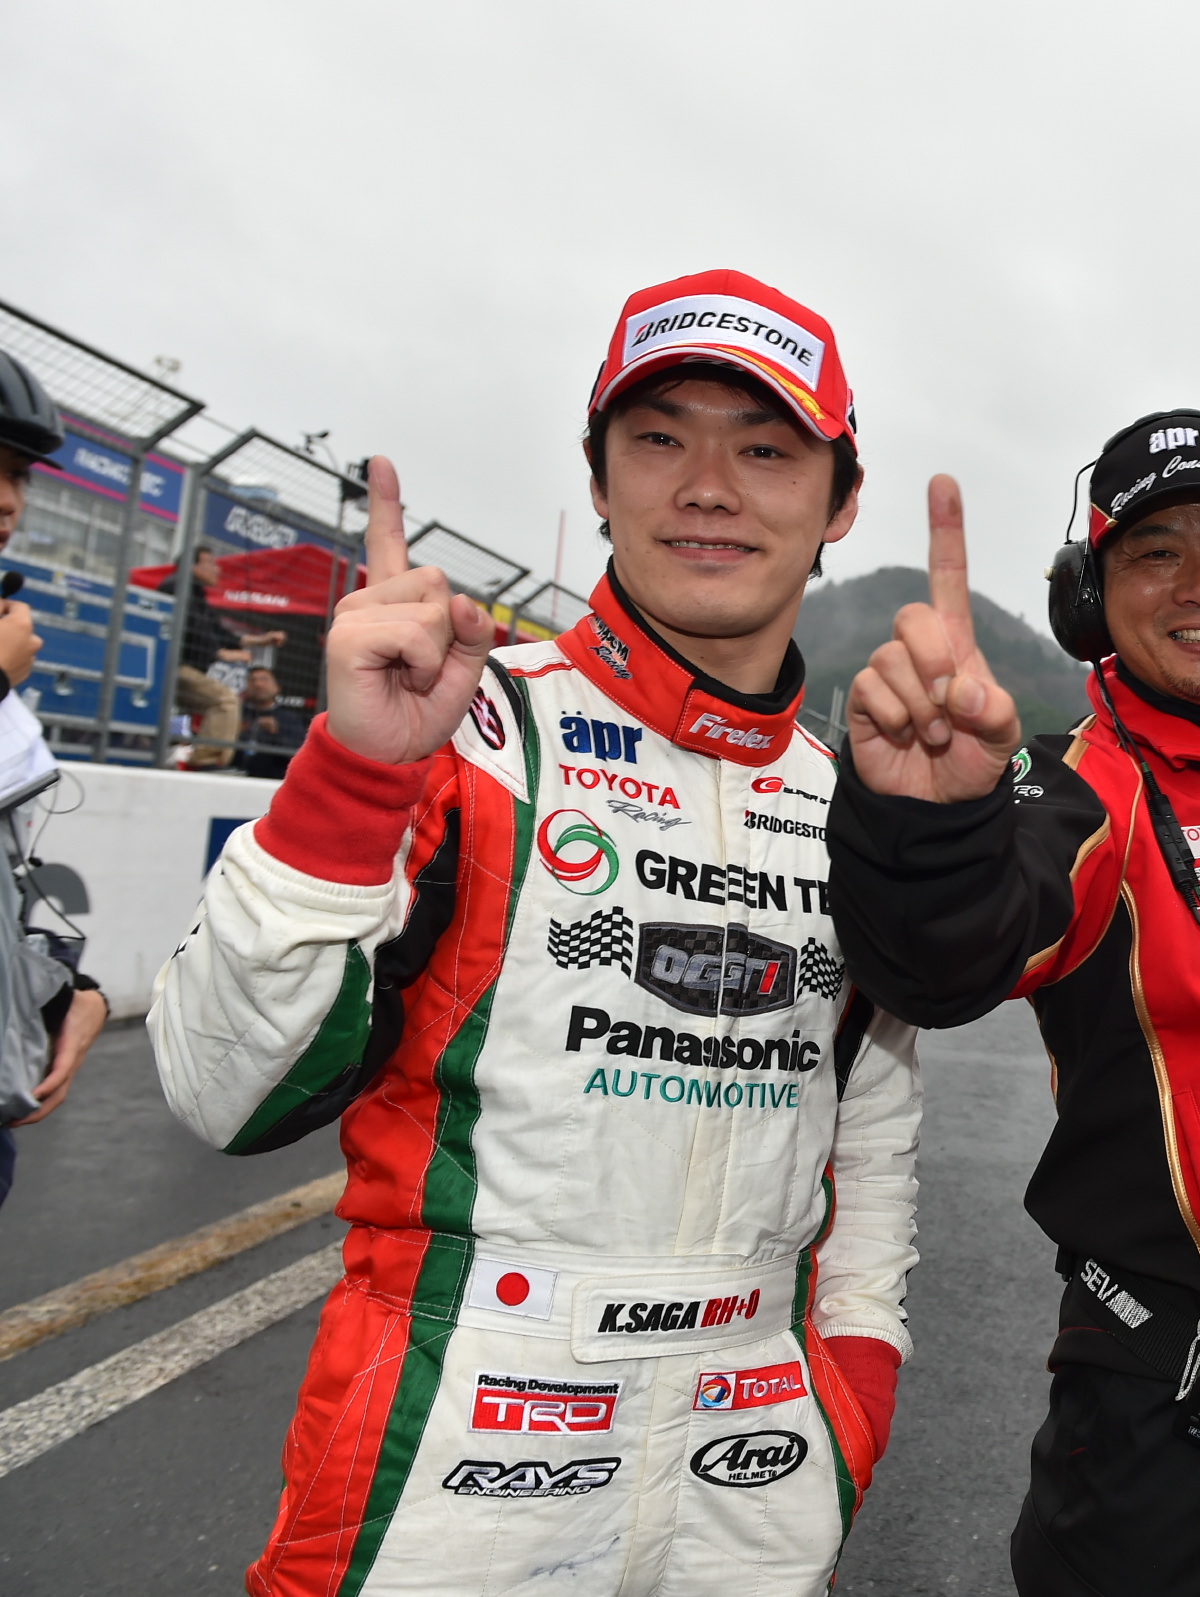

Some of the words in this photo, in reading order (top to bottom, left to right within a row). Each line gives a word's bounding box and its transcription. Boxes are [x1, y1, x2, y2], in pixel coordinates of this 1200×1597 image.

[631, 311, 814, 367] BRIDGESTONE
[1149, 427, 1199, 454] apr
[1110, 472, 1157, 512] Racing
[559, 711, 643, 765] apr
[689, 712, 775, 750] Firelex
[558, 763, 681, 810] TOYOTA
[607, 799, 692, 831] Racing
[744, 810, 827, 842] BRIDGESTO
[635, 849, 788, 912] GREEN
[793, 876, 832, 916] TE
[565, 1004, 821, 1072] Panasonic
[583, 1068, 800, 1109] AUTOMOTIVE
[1080, 1258, 1118, 1301] SEV
[597, 1301, 700, 1334] K.SAGA
[478, 1375, 527, 1392] Racing
[528, 1378, 619, 1395] Development
[739, 1374, 801, 1401] TOTAL
[481, 1396, 608, 1433] TRD
[700, 1435, 798, 1475] Arai
[446, 1460, 618, 1488] RAYS
[458, 1485, 591, 1497] ENGINEERING
[727, 1470, 773, 1482] HELMET
